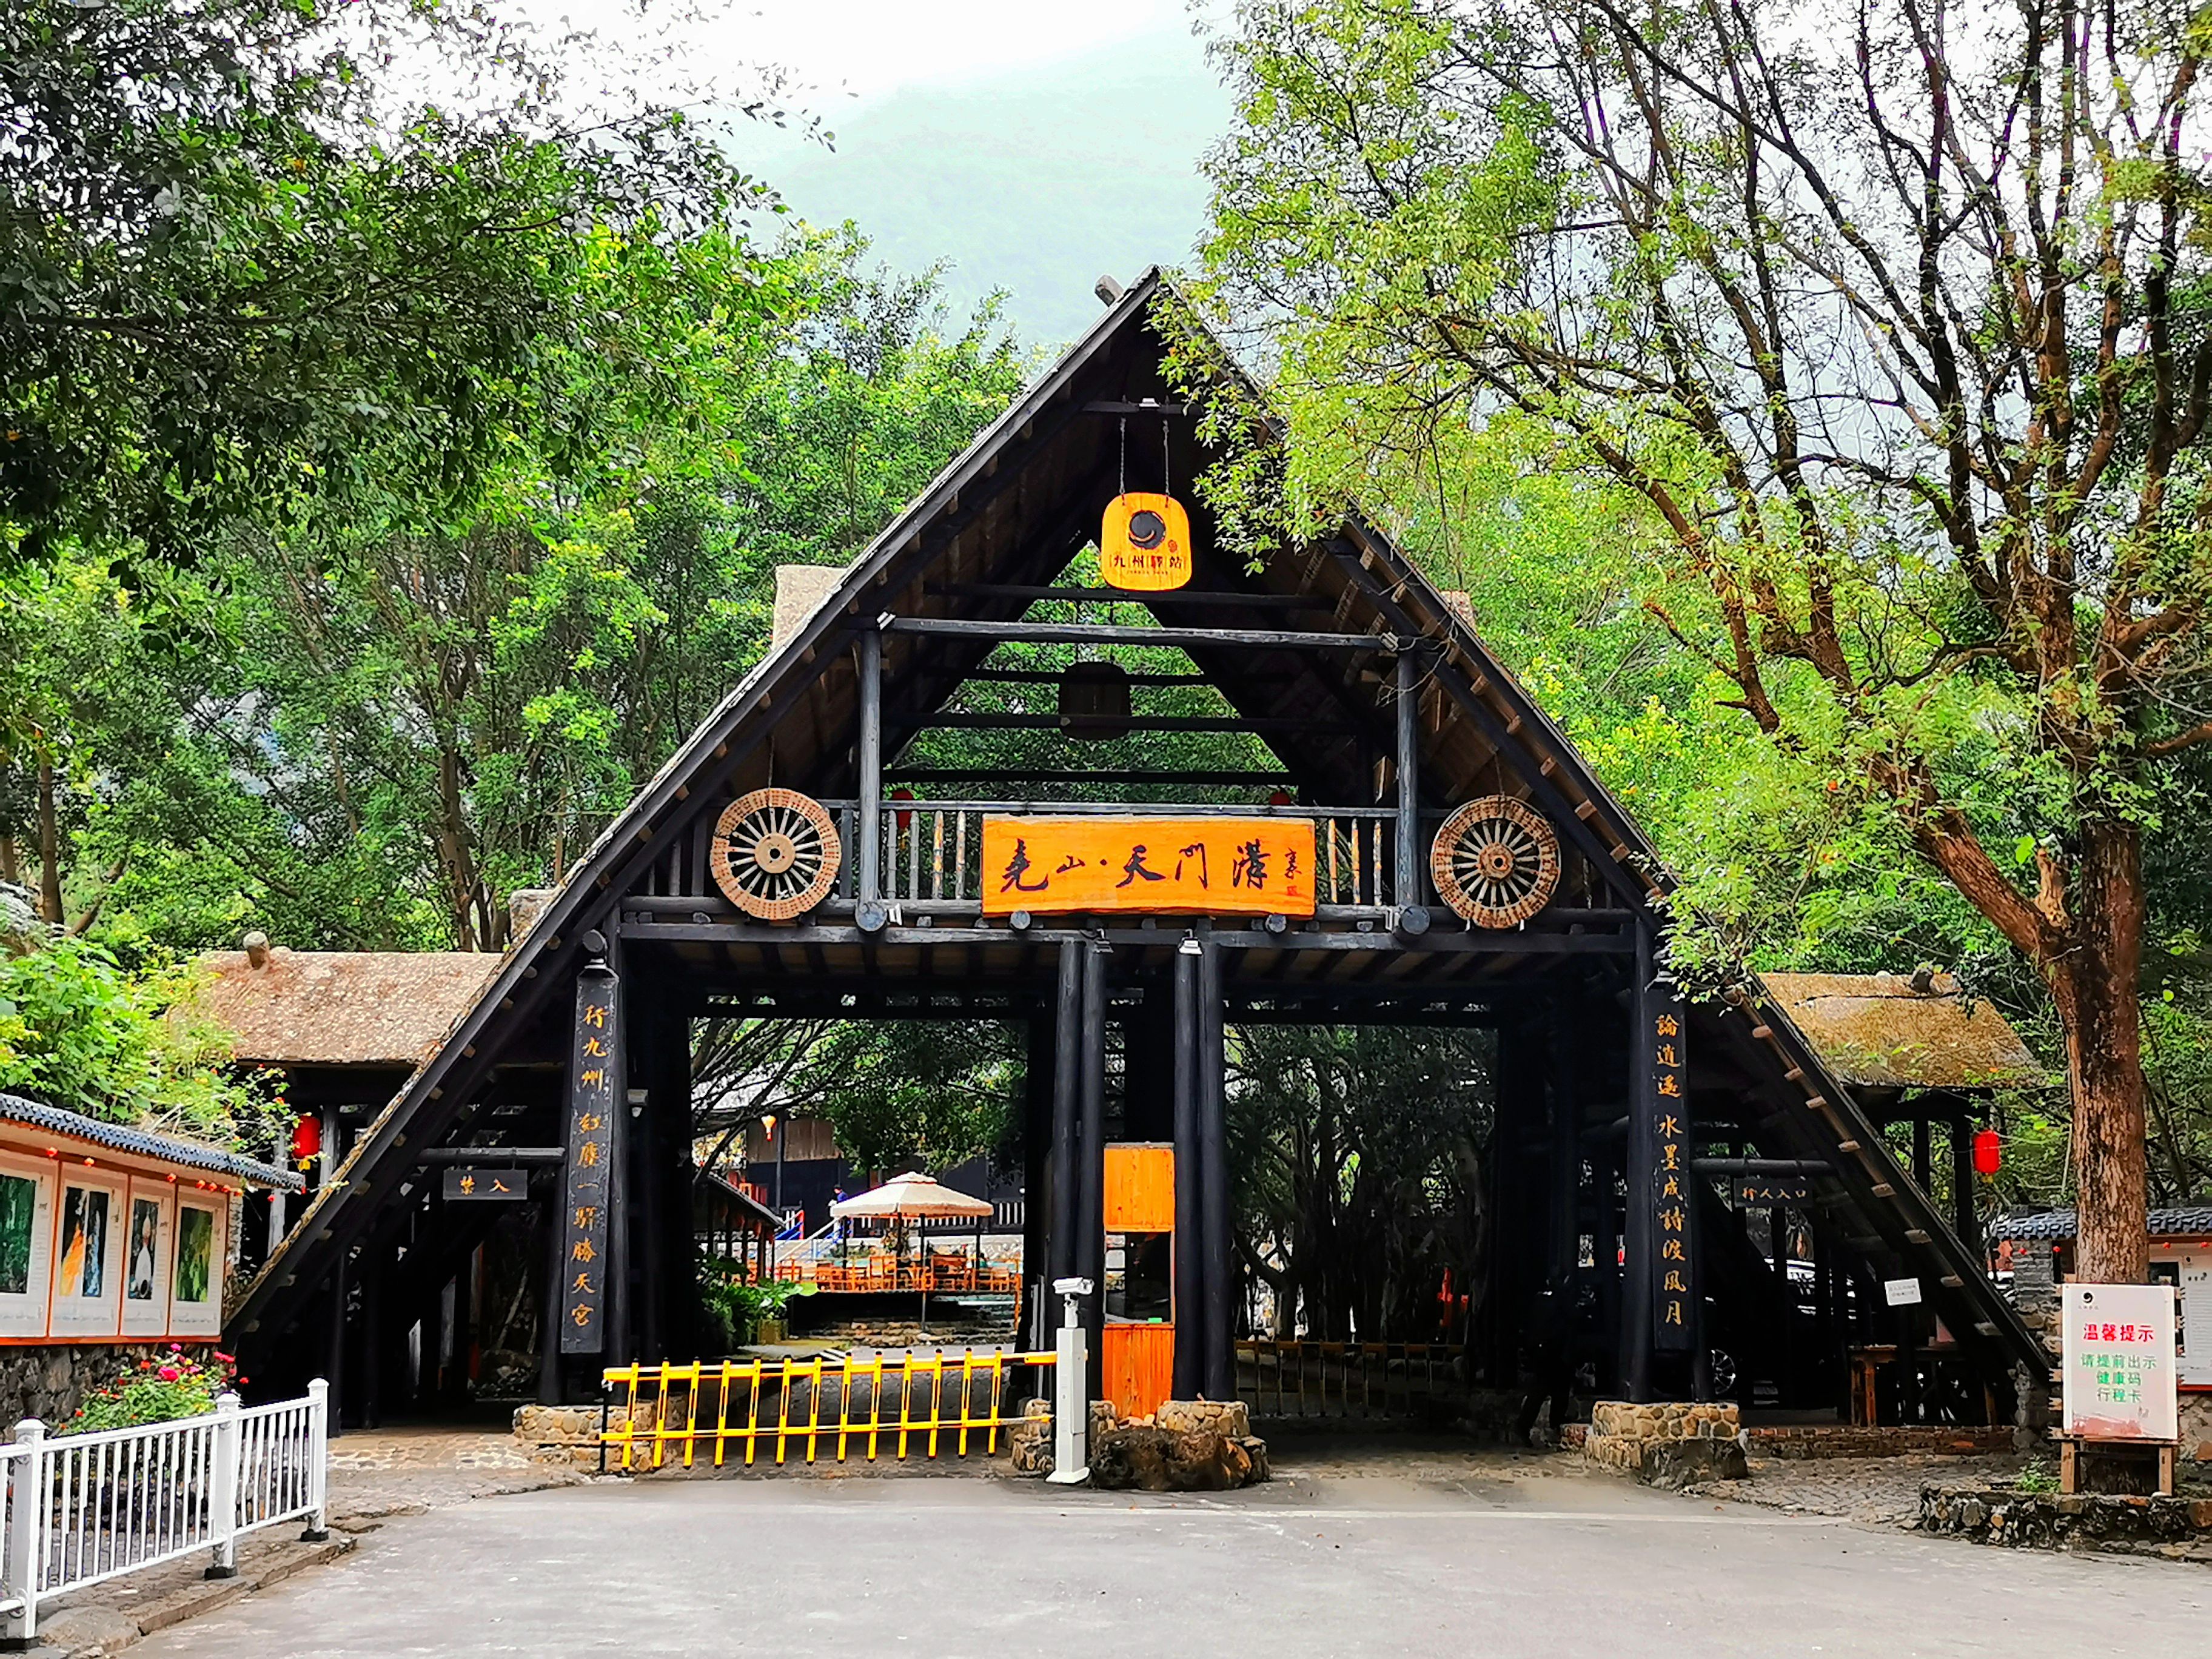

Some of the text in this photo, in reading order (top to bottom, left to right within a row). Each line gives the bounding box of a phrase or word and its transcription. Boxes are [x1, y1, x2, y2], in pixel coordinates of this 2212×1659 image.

[1742, 1187, 1807, 1202] 行人入口
[2083, 1323, 2154, 1342] 温馨提示
[2081, 1353, 2157, 1370] 请提前出示
[2096, 1371, 2142, 1386] 健康码
[2097, 1388, 2142, 1404] 行程卡
